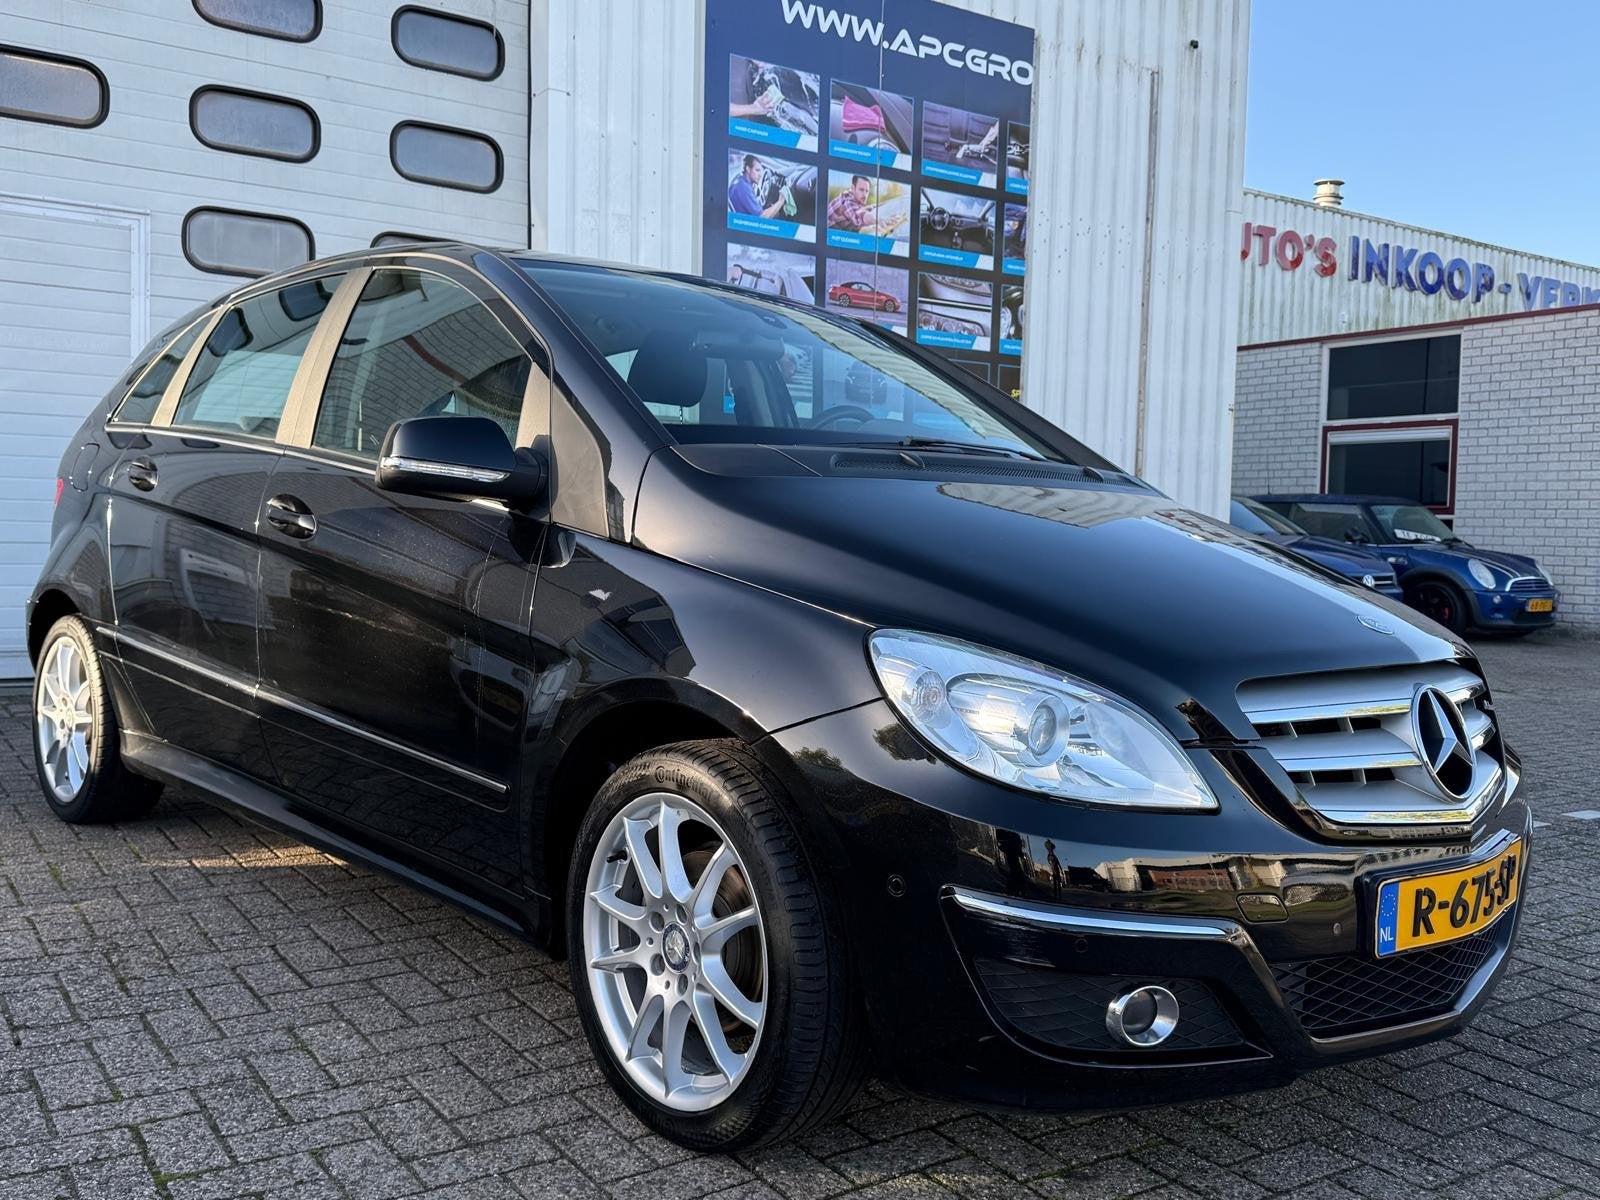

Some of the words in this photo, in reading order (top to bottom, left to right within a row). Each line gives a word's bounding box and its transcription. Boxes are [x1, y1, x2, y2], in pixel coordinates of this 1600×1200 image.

[781, 0, 1033, 86] WWW.APCGRO
[1348, 236, 1495, 303] INKOOP
[1412, 853, 1517, 937] R-675-SP
[1380, 927, 1394, 943] NL
